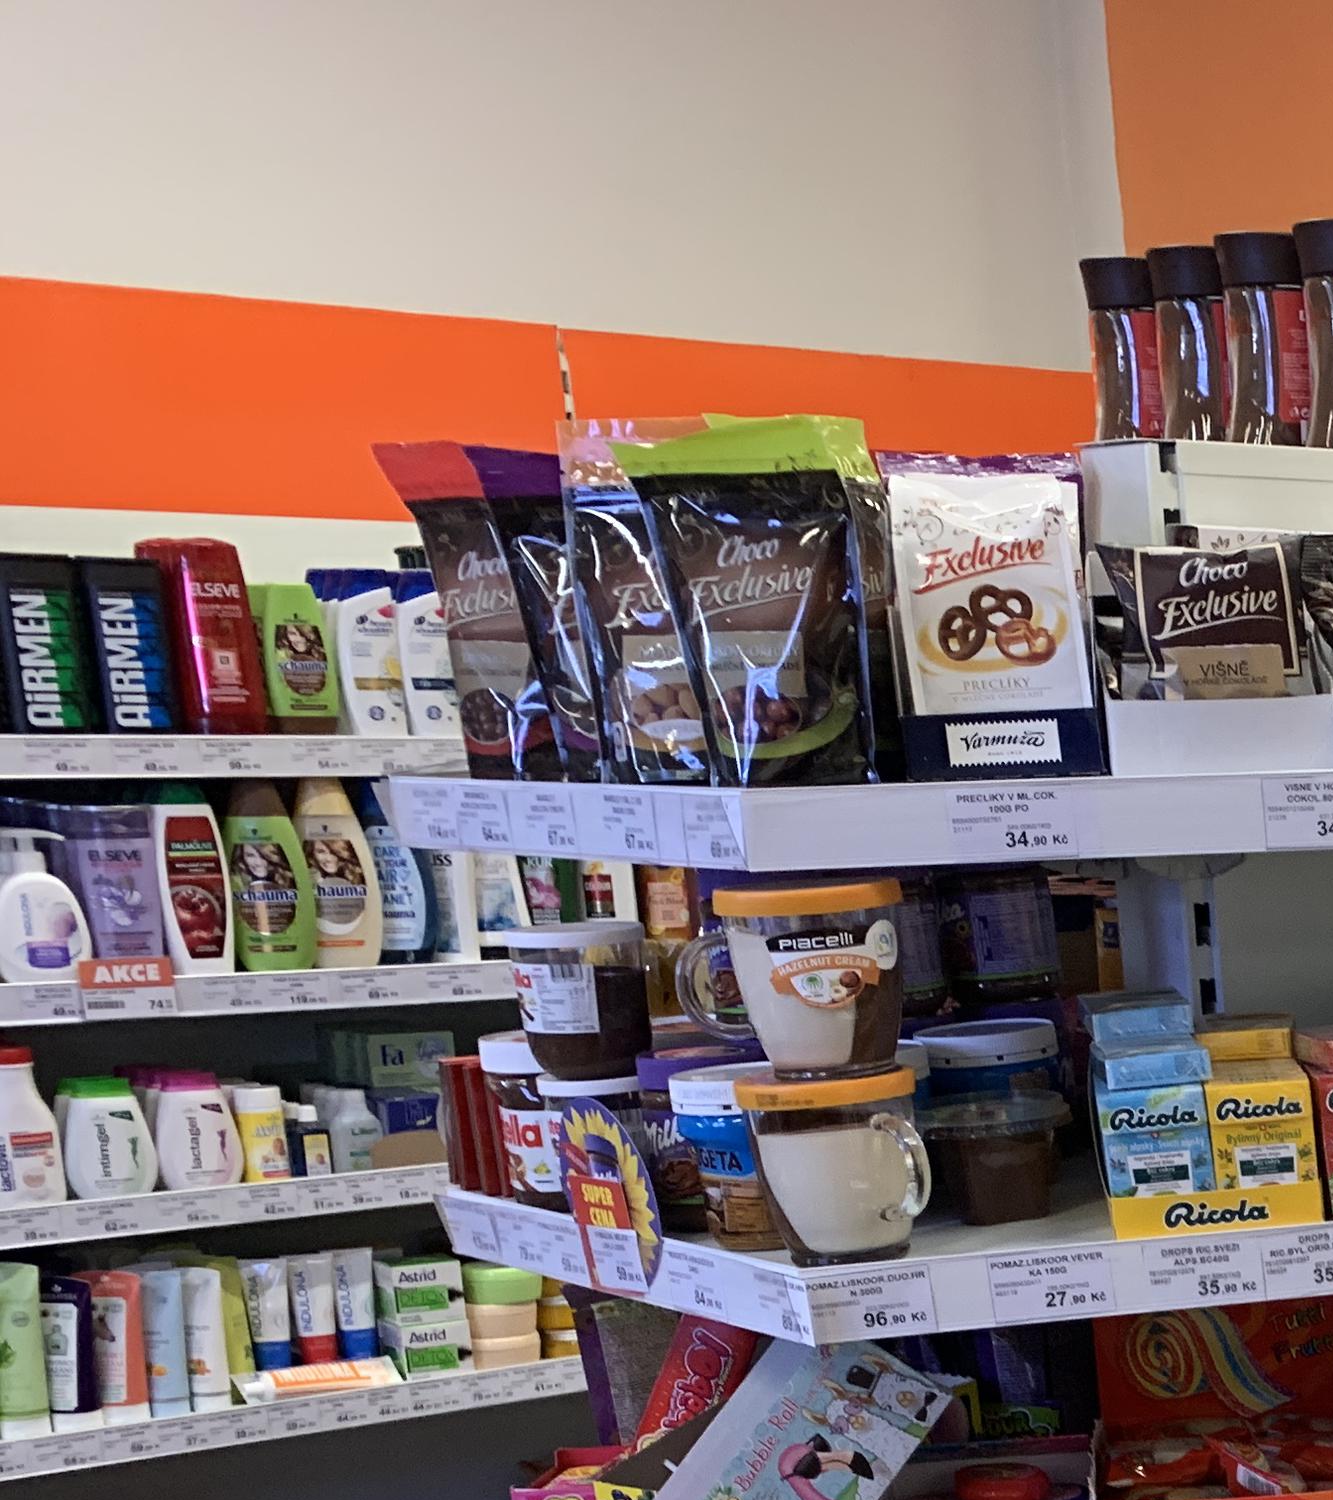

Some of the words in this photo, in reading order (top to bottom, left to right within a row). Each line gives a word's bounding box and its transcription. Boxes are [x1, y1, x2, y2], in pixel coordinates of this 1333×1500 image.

[718, 536, 779, 568] Choco
[915, 536, 1048, 589] Exclusive
[1178, 558, 1248, 588] Choco
[688, 566, 812, 616] Exclusive
[1155, 588, 1278, 640] Exclusive
[1005, 832, 1048, 848] 34,90
[1052, 834, 1069, 845] Kč
[233, 888, 297, 902] schauma
[93, 964, 160, 983] AKCE
[1110, 1106, 1198, 1131] Ricola
[1216, 1096, 1302, 1121] Ricola
[581, 1184, 615, 1206] SUPER
[1165, 1200, 1268, 1229] Ricola
[398, 1269, 437, 1284] Astrid
[1197, 1278, 1238, 1296] 35,90
[1243, 1281, 1257, 1292] Kč
[1045, 1291, 1087, 1308] 27,90
[1090, 1291, 1107, 1302] Kč
[863, 1311, 906, 1328] 96,90
[911, 1311, 927, 1322] Kč
[408, 1329, 447, 1344] Astrid
[734, 1432, 777, 1491] Bubble
